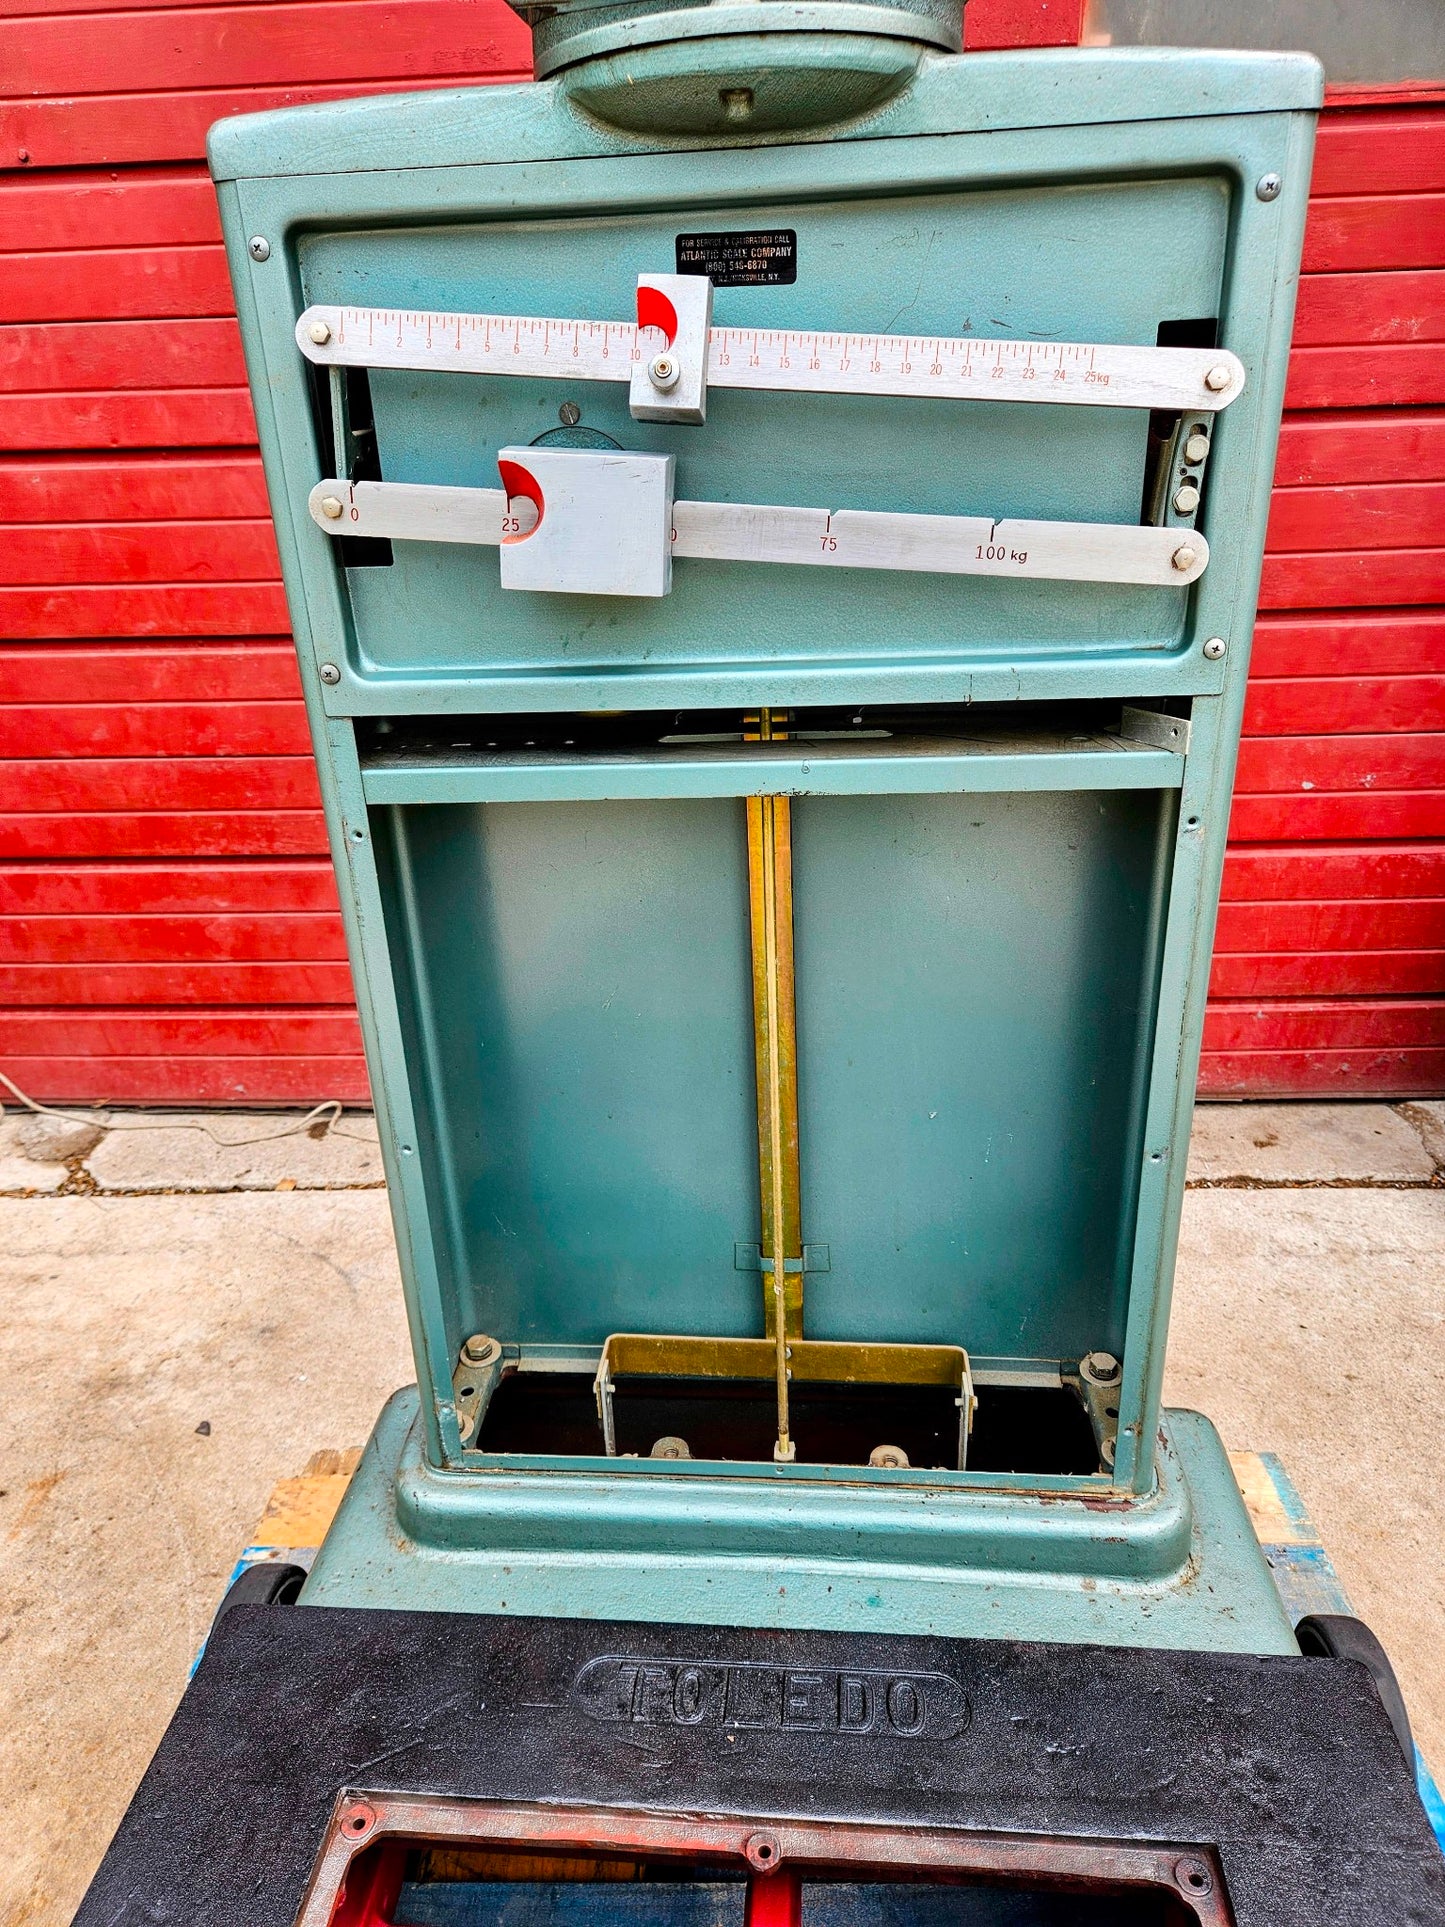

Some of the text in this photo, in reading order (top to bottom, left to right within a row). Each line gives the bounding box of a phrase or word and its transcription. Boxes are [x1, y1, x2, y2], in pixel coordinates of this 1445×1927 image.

[680, 246, 792, 261] ATLANTIC SCALE COMPANY
[681, 239, 694, 248] FOR
[696, 238, 721, 248] SERVICE
[731, 235, 773, 247] CALIBRATION
[774, 234, 790, 244] CALL
[705, 261, 726, 273] (800)
[338, 333, 345, 344] 0
[368, 335, 373, 346] 1
[396, 336, 403, 348] 2
[426, 338, 432, 349] 3
[454, 340, 461, 351] 4
[484, 341, 491, 352] 5
[513, 343, 520, 355] 6
[543, 344, 549, 356] 7
[572, 346, 579, 357] 8
[602, 347, 609, 359] 9
[630, 349, 641, 361] 10
[719, 354, 730, 366] 13
[749, 355, 760, 367] 14
[779, 356, 790, 369] 15
[808, 358, 820, 370] 16
[839, 359, 851, 372] 17
[869, 361, 881, 373] 18
[900, 362, 911, 374] 19
[929, 363, 943, 376] 20
[961, 365, 972, 377] 21
[991, 366, 1004, 378] 22
[1022, 368, 1035, 380] 23
[1053, 369, 1066, 381] 24
[350, 508, 359, 522] 0
[501, 517, 520, 532] 25
[819, 536, 838, 552] 75
[974, 545, 1006, 561] 100
[1009, 549, 1028, 565] kg
[619, 1662, 928, 1738] TOLEDO
